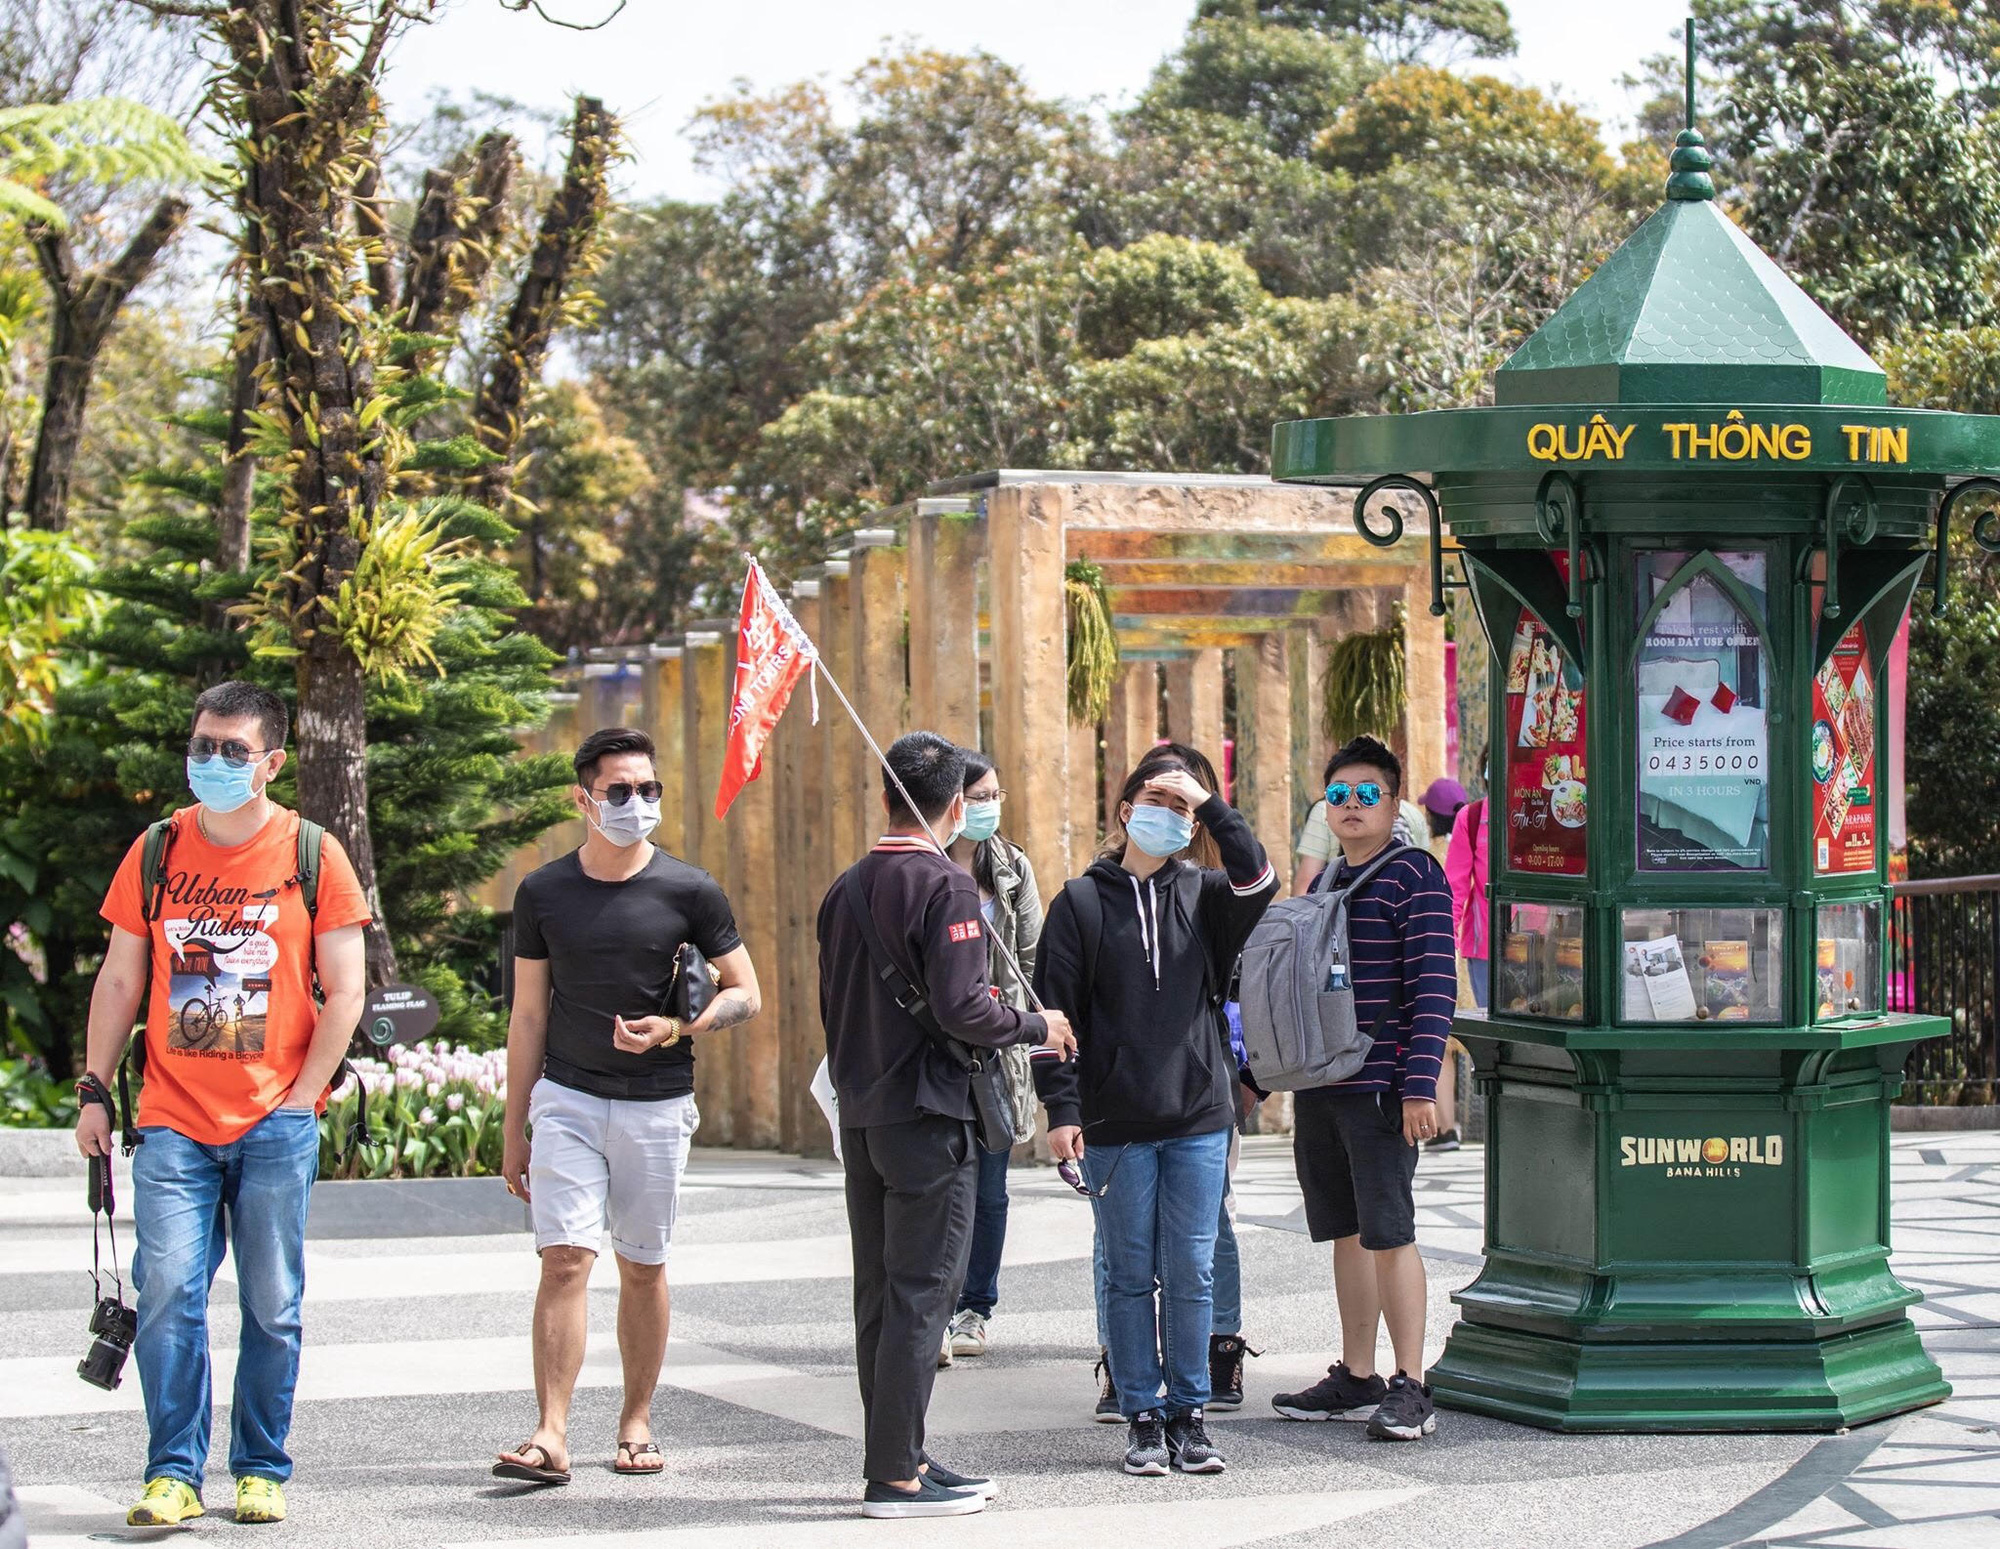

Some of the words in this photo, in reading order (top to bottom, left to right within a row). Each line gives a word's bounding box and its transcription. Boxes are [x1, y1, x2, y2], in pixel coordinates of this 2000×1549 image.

[1526, 413, 1638, 462] QUÂY
[1662, 409, 1812, 461] THÔNG
[1841, 424, 1909, 464] TIN
[1699, 626, 1719, 635] rest
[1722, 624, 1747, 635] with
[1645, 637, 1676, 647] ROOM
[1678, 637, 1701, 647] DAY
[1703, 637, 1724, 647] USE
[750, 644, 793, 694] TOURS
[1653, 736, 1685, 748] Price
[1688, 737, 1723, 748] starts
[1725, 735, 1756, 748] from
[1744, 778, 1762, 786] VND
[1669, 786, 1683, 797] IN
[1686, 786, 1693, 797] 3
[1696, 785, 1742, 797] HOURS
[167, 871, 250, 905] Urban
[176, 905, 259, 941] Riders
[382, 991, 414, 1002] TULIP
[371, 1002, 406, 1012] FLAMING
[405, 1000, 428, 1010] FLAG
[184, 1048, 198, 1058] like
[199, 1049, 227, 1061] Riding
[235, 1050, 264, 1062] Bicycle
[1666, 1167, 1703, 1178] BANA
